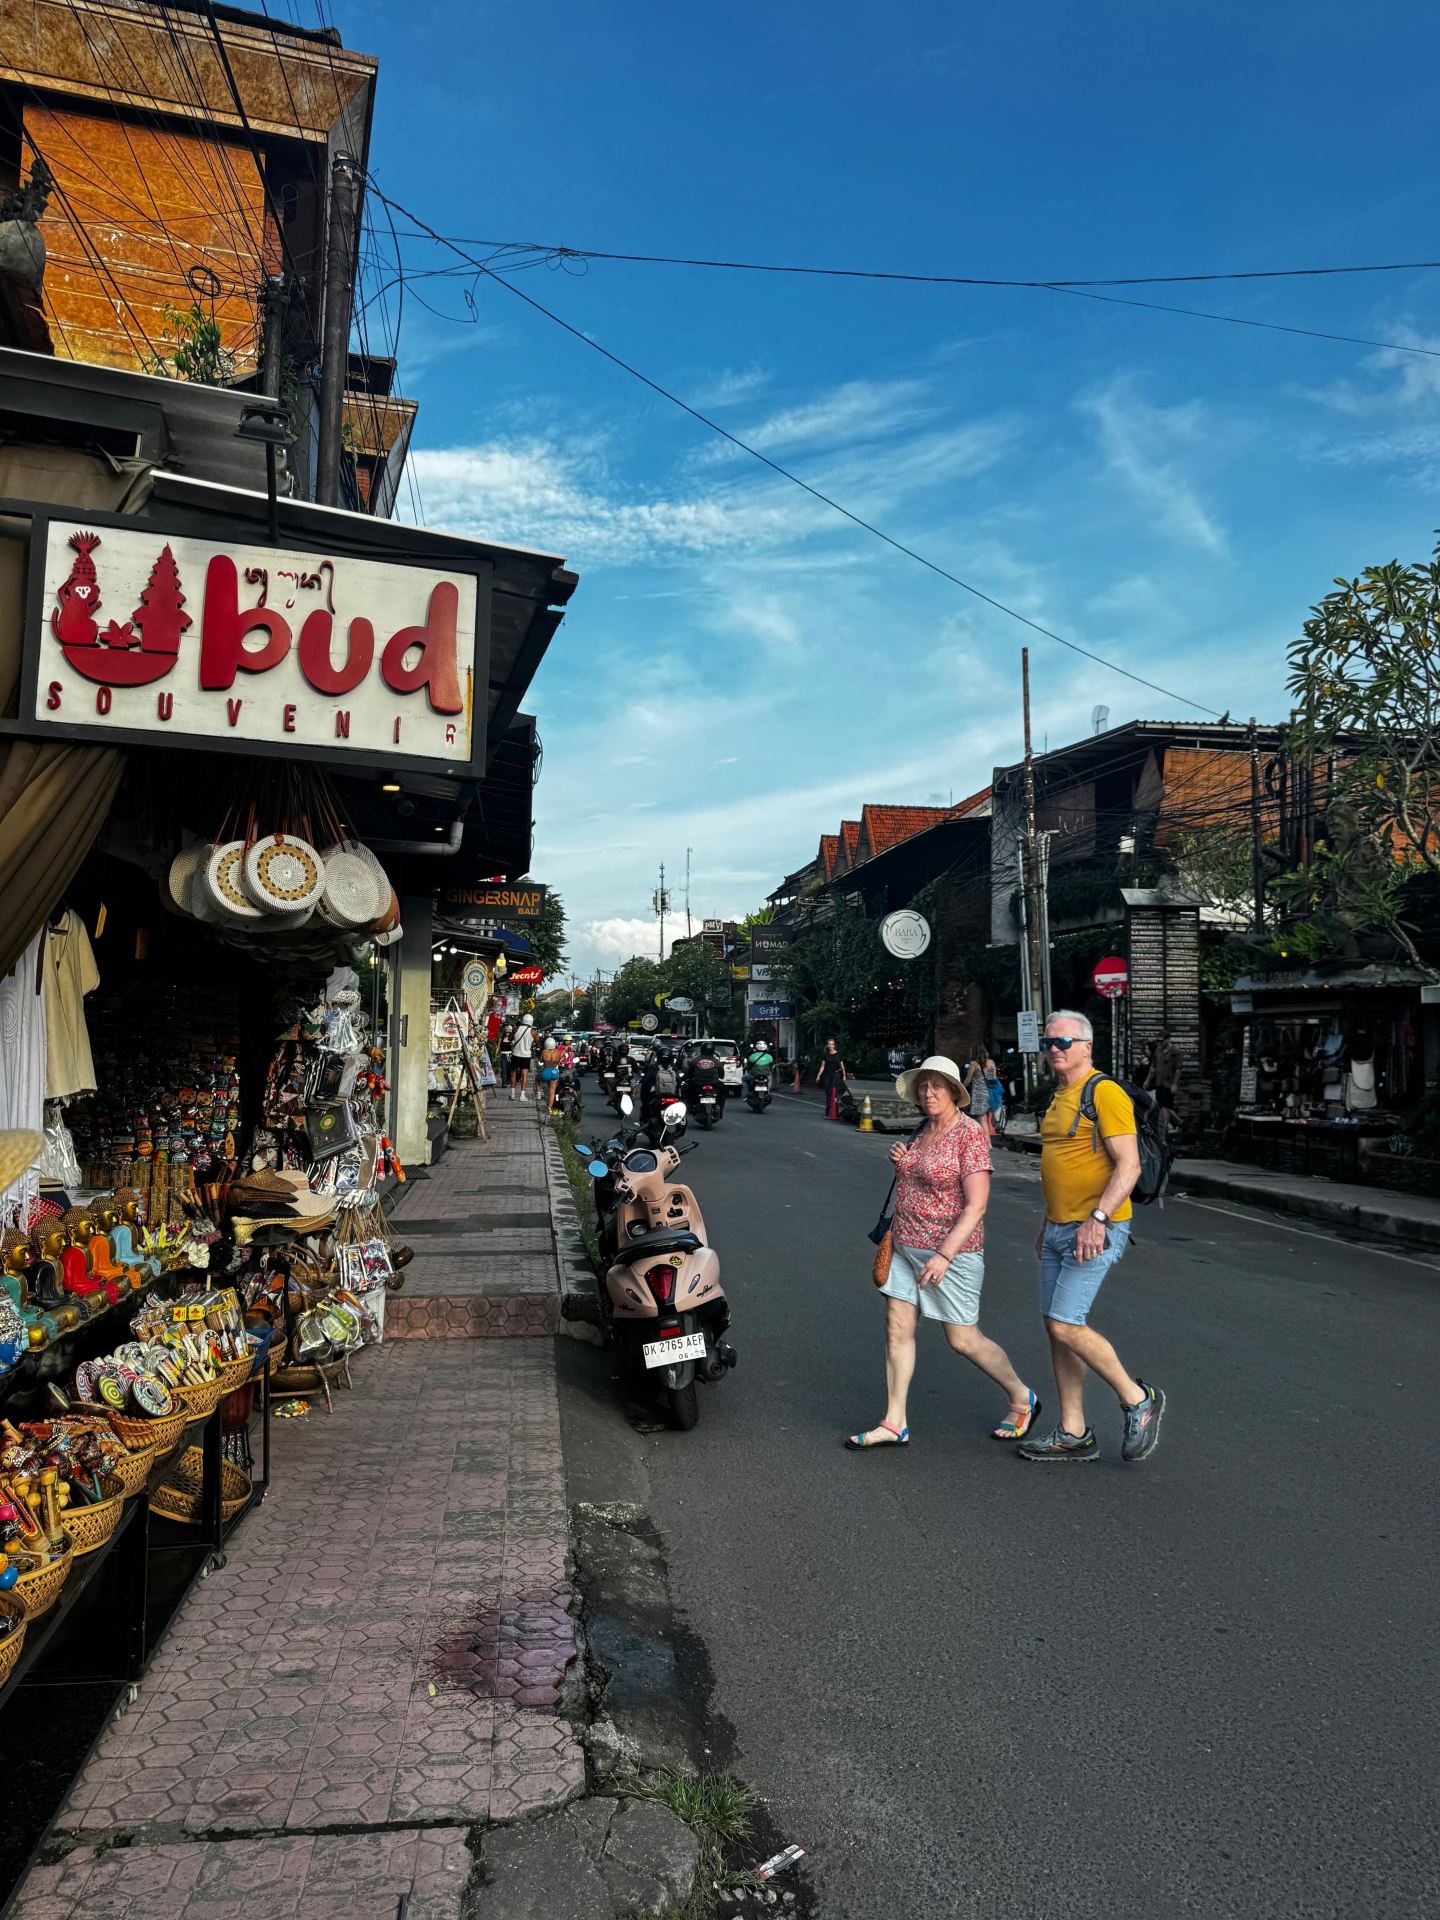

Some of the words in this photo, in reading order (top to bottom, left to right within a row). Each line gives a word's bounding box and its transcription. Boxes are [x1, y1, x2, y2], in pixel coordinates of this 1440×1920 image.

[47, 680, 456, 745] SOUVENIR
[446, 888, 540, 907] GINGERSNAP
[518, 907, 539, 915] BALI
[644, 1344, 657, 1356] DK
[660, 1338, 683, 1353] 2765
